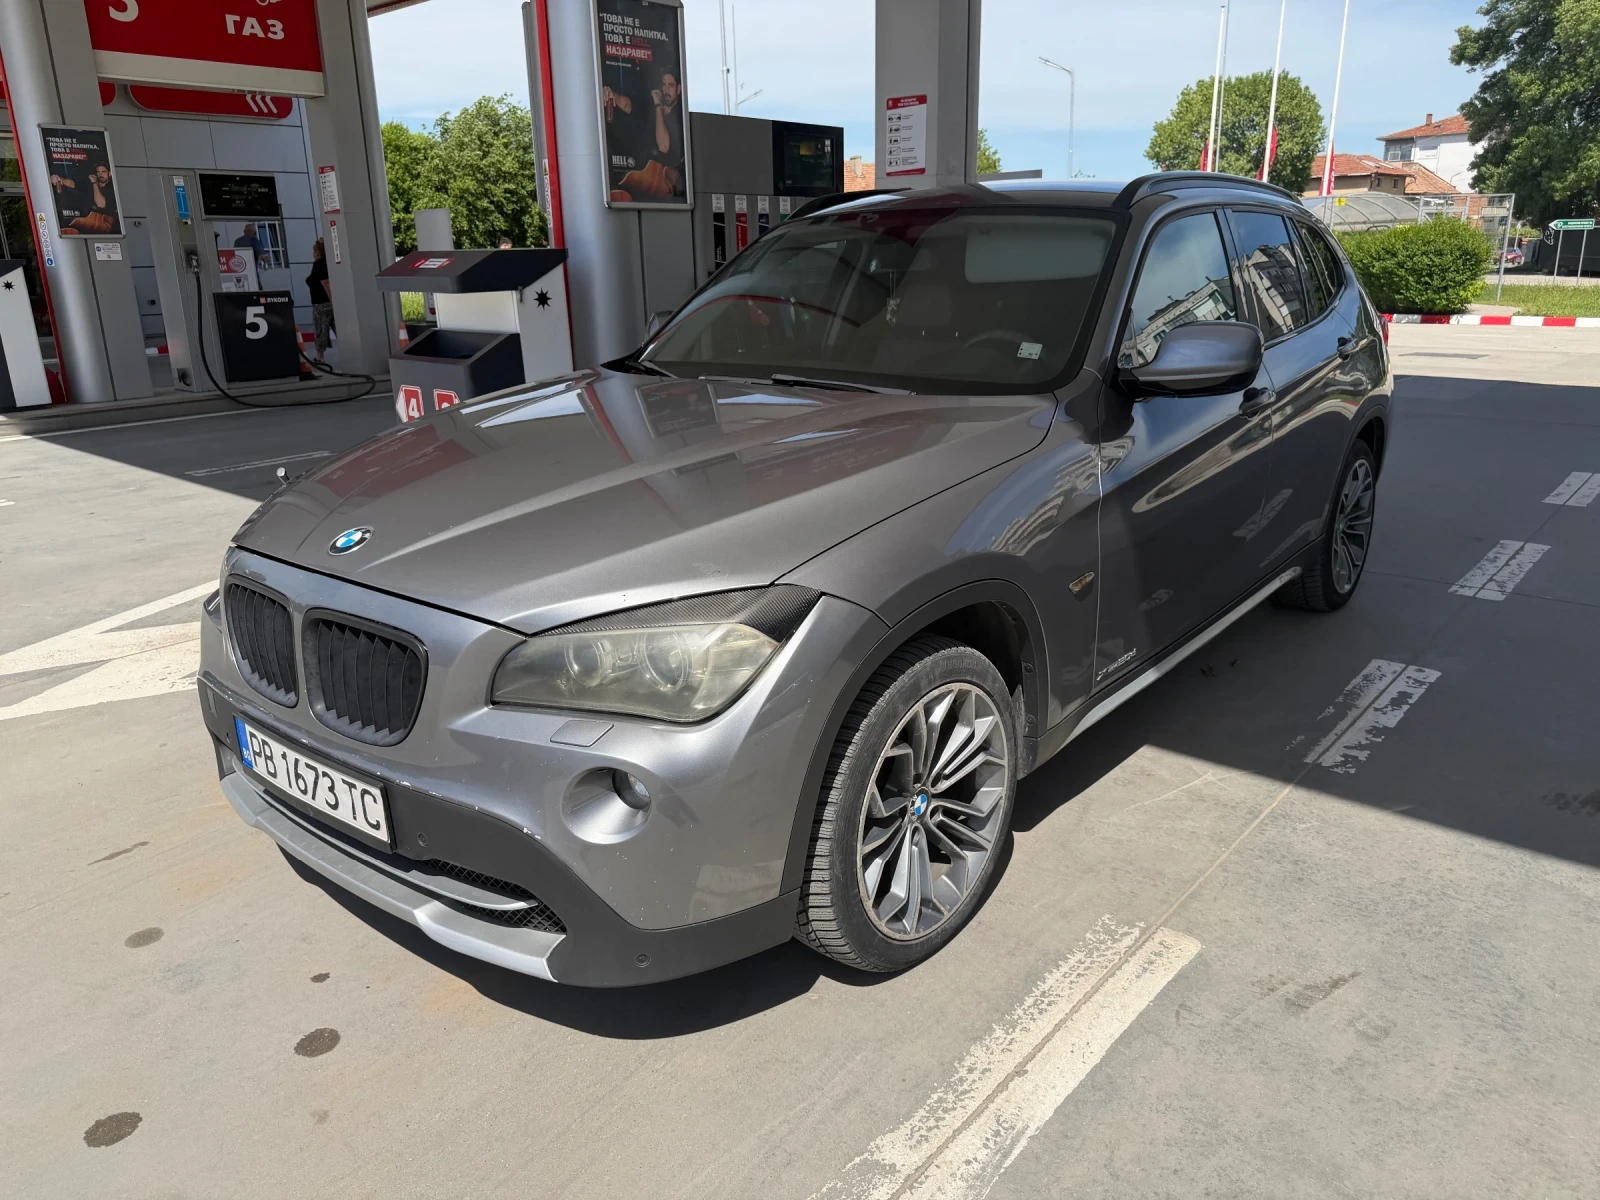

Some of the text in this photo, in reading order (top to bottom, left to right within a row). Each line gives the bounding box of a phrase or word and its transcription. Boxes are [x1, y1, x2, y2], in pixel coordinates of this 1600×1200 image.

[225, 13, 285, 40] ГАЗ
[624, 16, 634, 26] НЕ
[635, 18, 640, 27] Е
[603, 22, 669, 41] ПРОСТО НАПИТКА.
[604, 33, 624, 43] ТОВА
[625, 35, 631, 45] Е
[612, 155, 627, 165] HELL
[245, 305, 269, 340] 5
[280, 750, 340, 811] 1673
